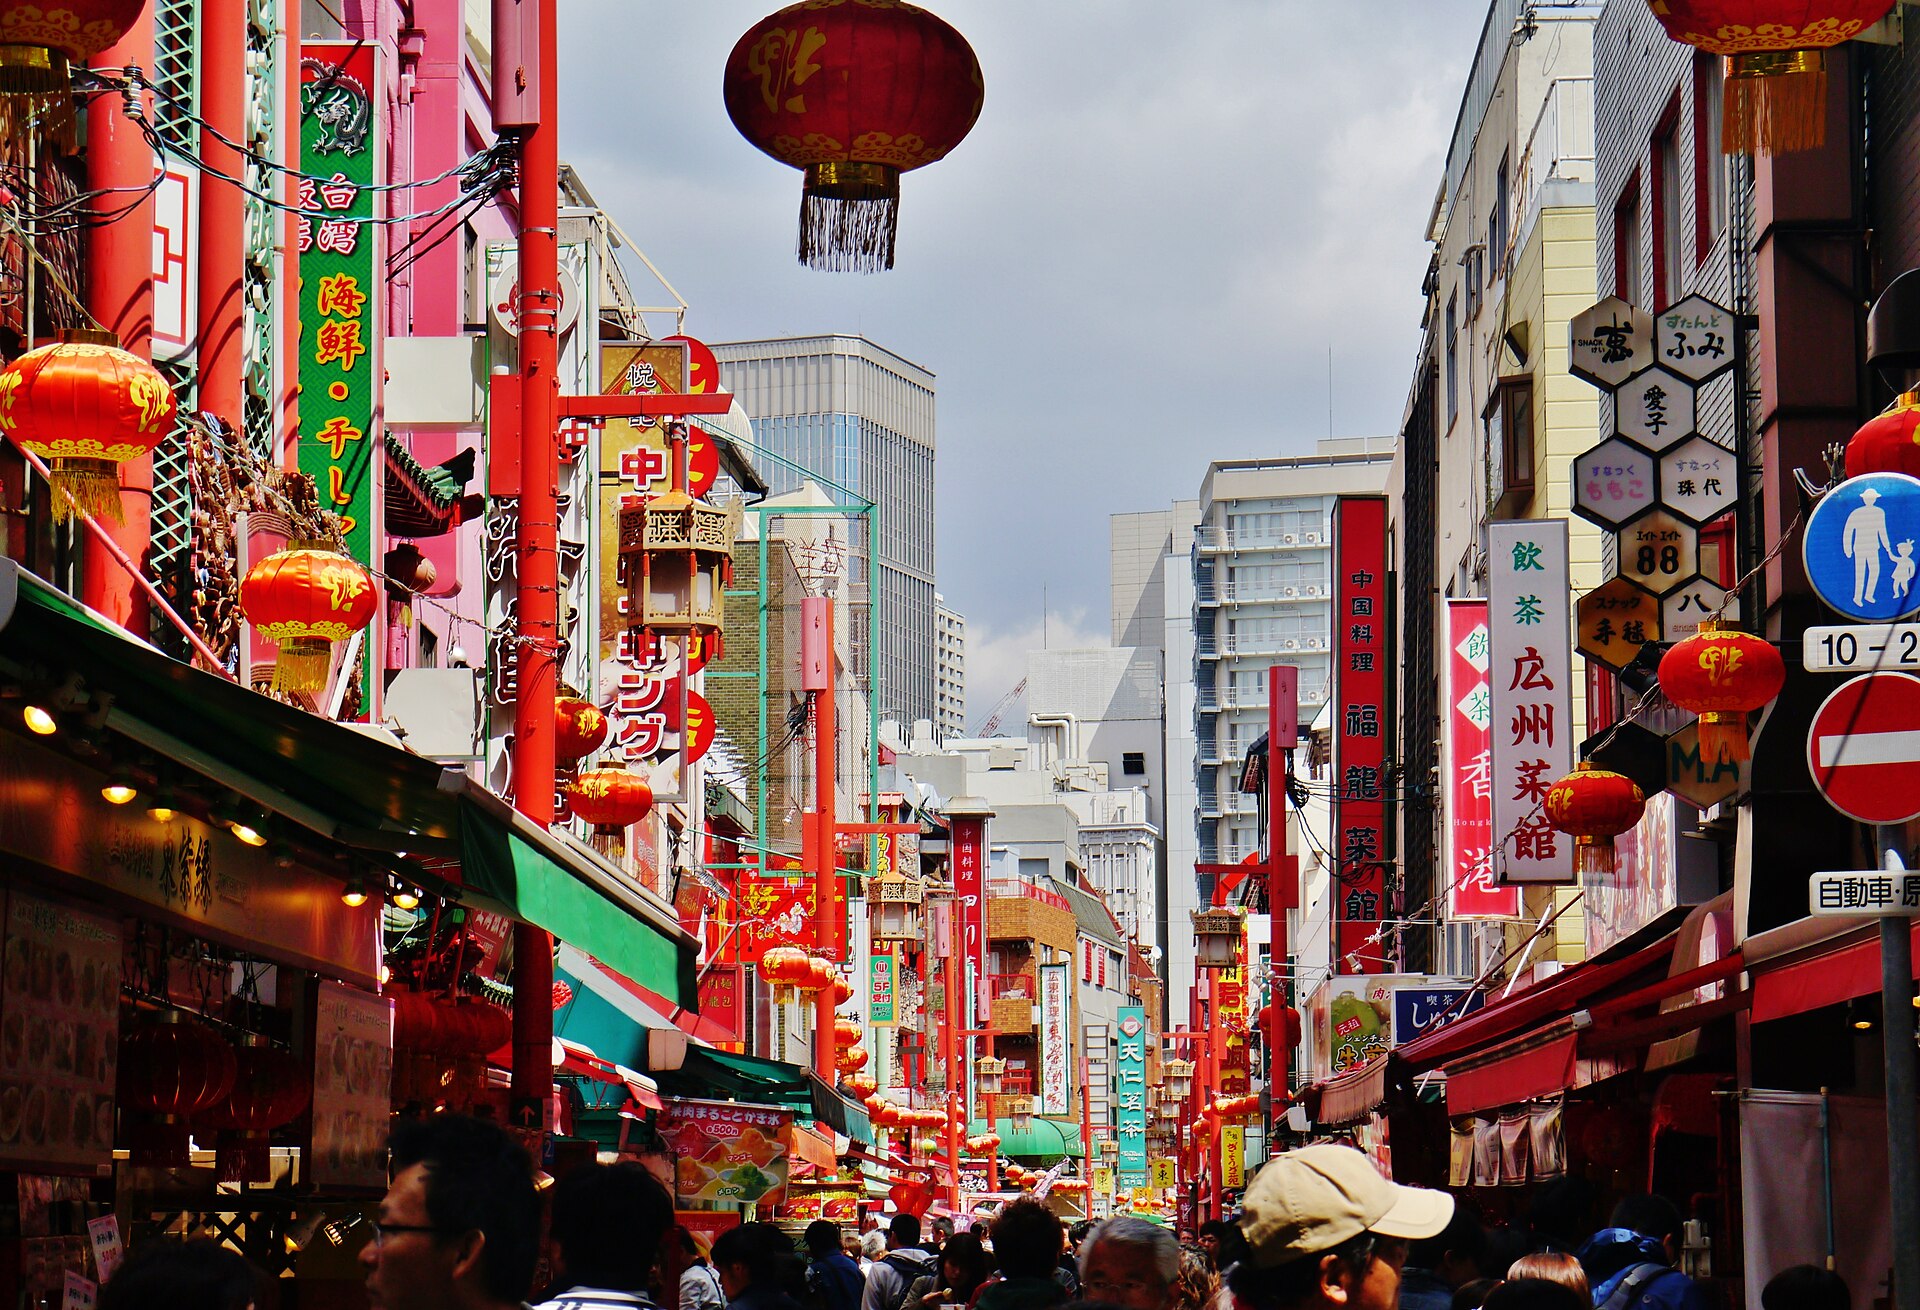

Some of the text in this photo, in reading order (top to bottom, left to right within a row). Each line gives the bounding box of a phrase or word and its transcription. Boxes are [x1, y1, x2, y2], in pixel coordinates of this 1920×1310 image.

[1665, 314, 1722, 330] すたんど
[1577, 338, 1604, 347] SNACK
[1667, 332, 1725, 360] ふみ
[1643, 385, 1668, 436] 愛子
[1592, 465, 1635, 477] すなっく
[1675, 459, 1720, 473] すなっく
[1585, 480, 1644, 500] ももこ
[1677, 478, 1723, 497] 珠代
[1636, 545, 1680, 576] 88
[1595, 596, 1641, 609] スナック
[1351, 569, 1375, 672] 中国料理
[1345, 704, 1380, 922] 福龍菜館
[961, 828, 974, 881] 中国料理
[874, 982, 890, 992] 5F
[872, 994, 891, 1003] 受付
[1427, 995, 1453, 1006] 喫茶
[1119, 1043, 1144, 1139] 天仁茗茶
[727, 1152, 753, 1163] マンゴー
[716, 1187, 740, 1195] メロン
